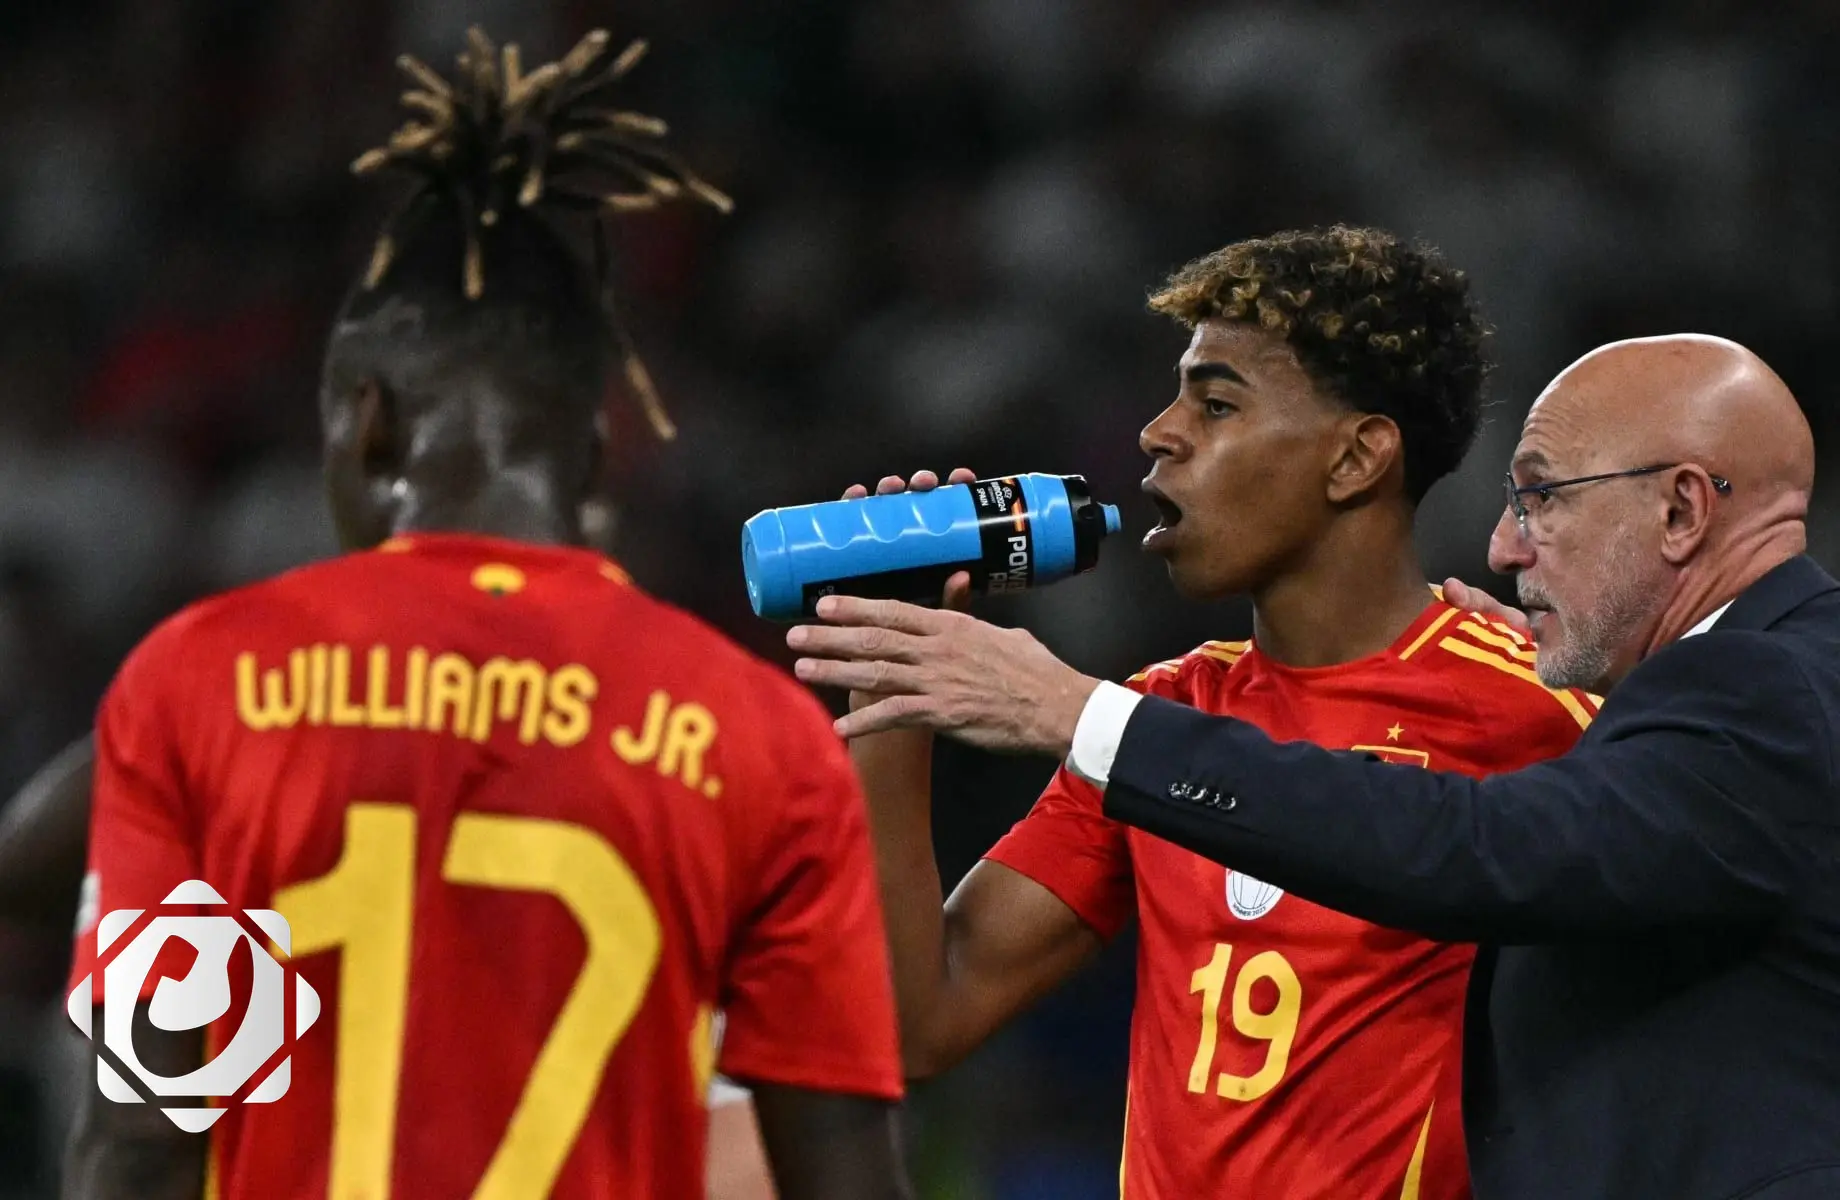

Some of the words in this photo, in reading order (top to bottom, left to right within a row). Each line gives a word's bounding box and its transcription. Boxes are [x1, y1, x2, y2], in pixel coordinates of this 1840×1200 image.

[976, 487, 989, 506] SPAIN
[236, 643, 599, 747] WILLIAMS
[610, 690, 722, 798] JR.
[269, 803, 661, 1200] 17
[1188, 943, 1302, 1102] 19
